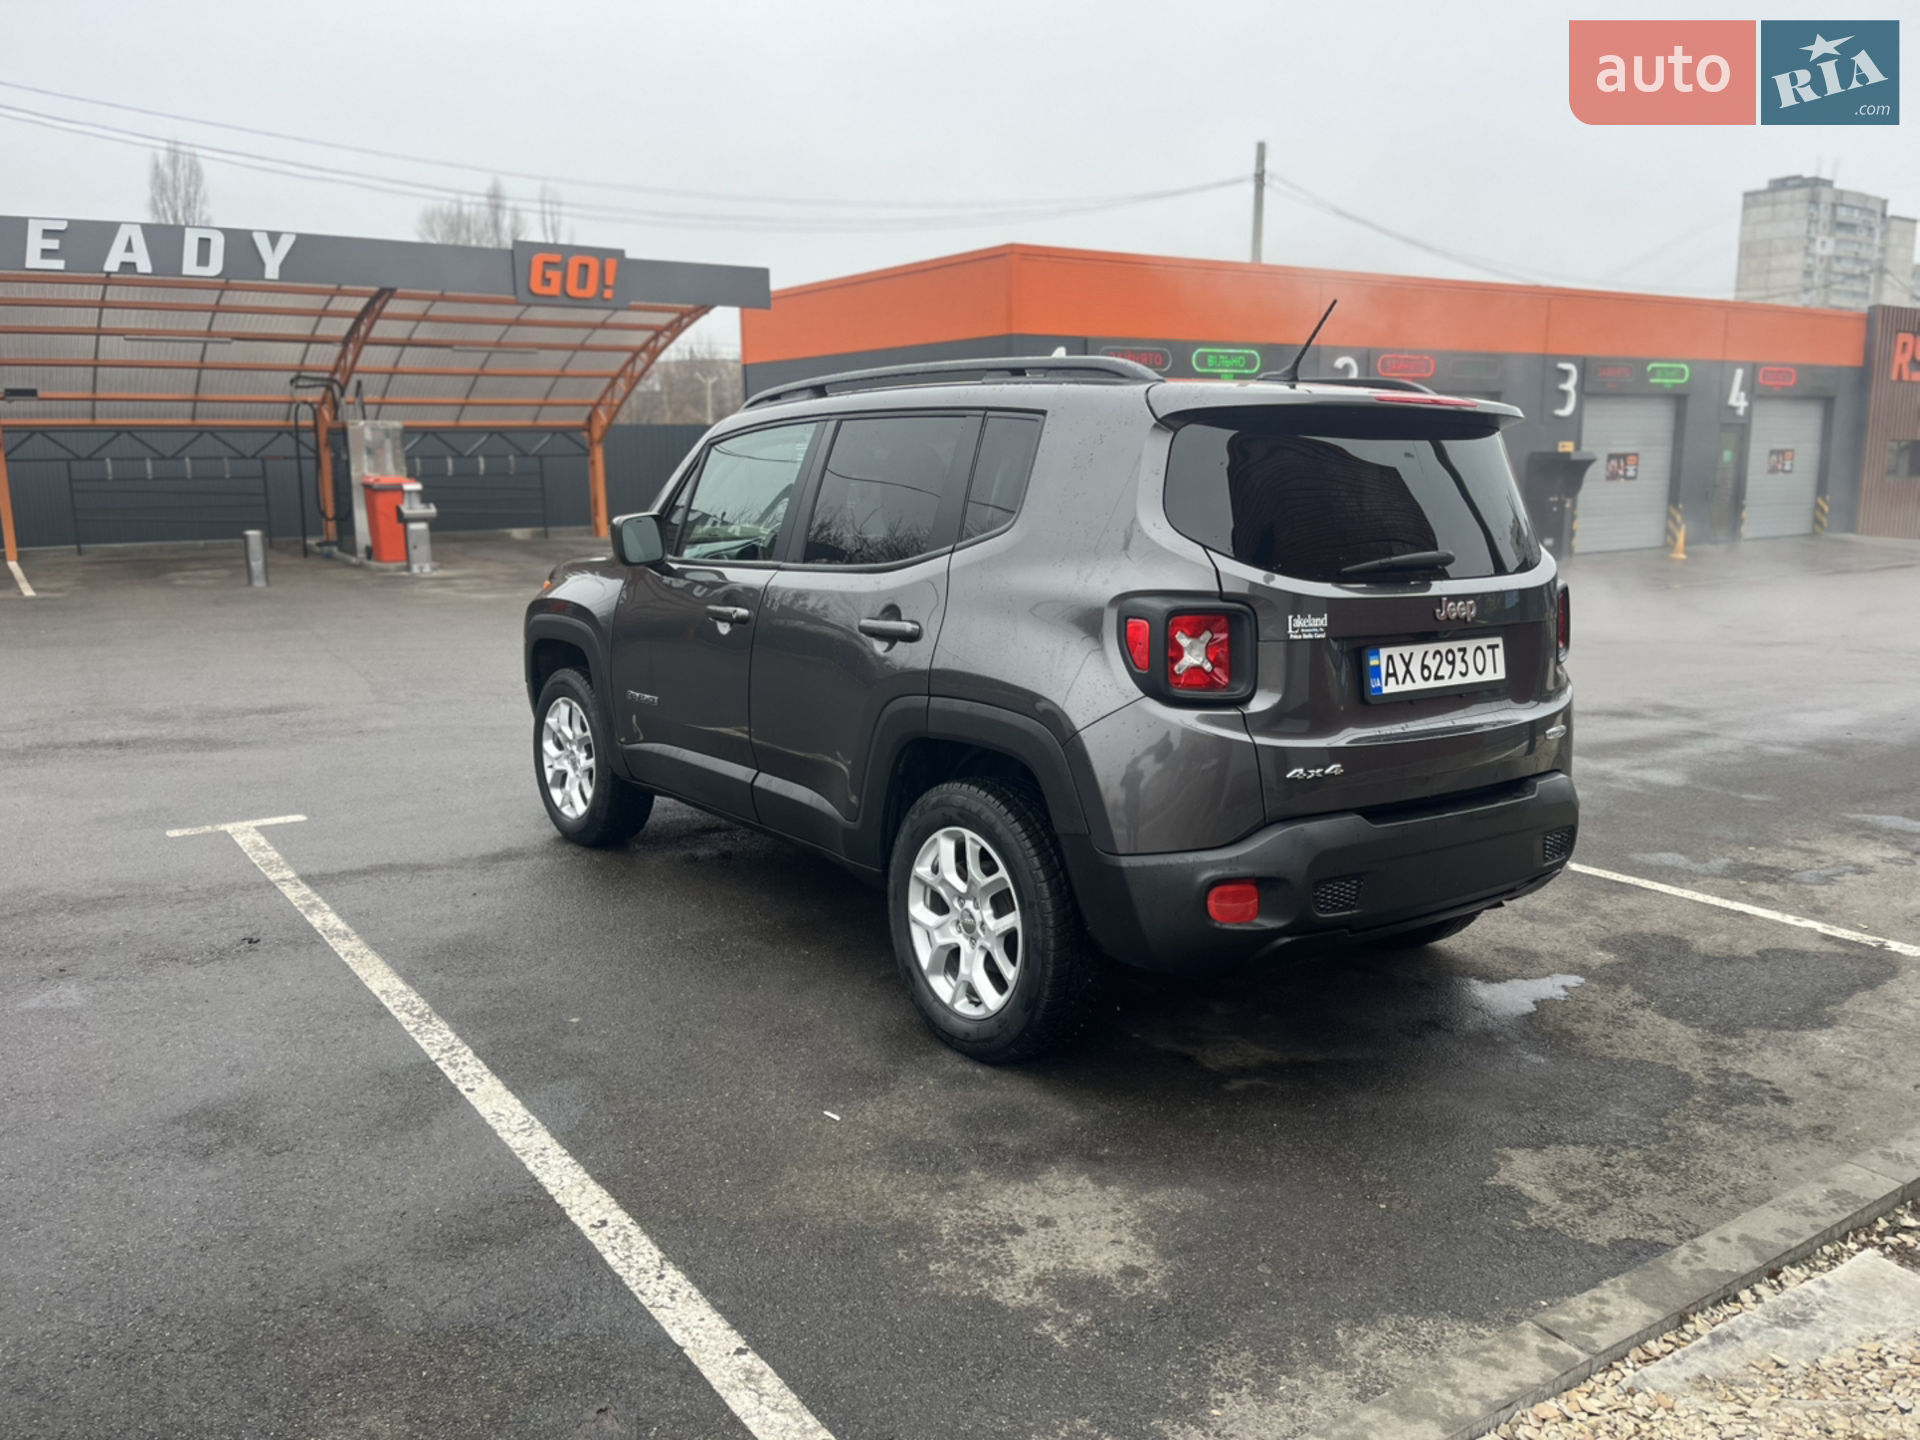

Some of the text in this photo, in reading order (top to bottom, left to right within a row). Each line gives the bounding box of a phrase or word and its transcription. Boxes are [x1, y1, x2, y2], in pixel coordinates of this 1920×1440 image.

[529, 252, 618, 300] GO!
[1553, 362, 1578, 417] 3
[1728, 368, 1748, 416] 4
[1287, 613, 1328, 634] Lakeland
[1434, 597, 1477, 622] Jeep
[1384, 644, 1500, 687] AX 6293 OT
[1370, 678, 1382, 688] UA
[1285, 764, 1344, 780] 4x4
